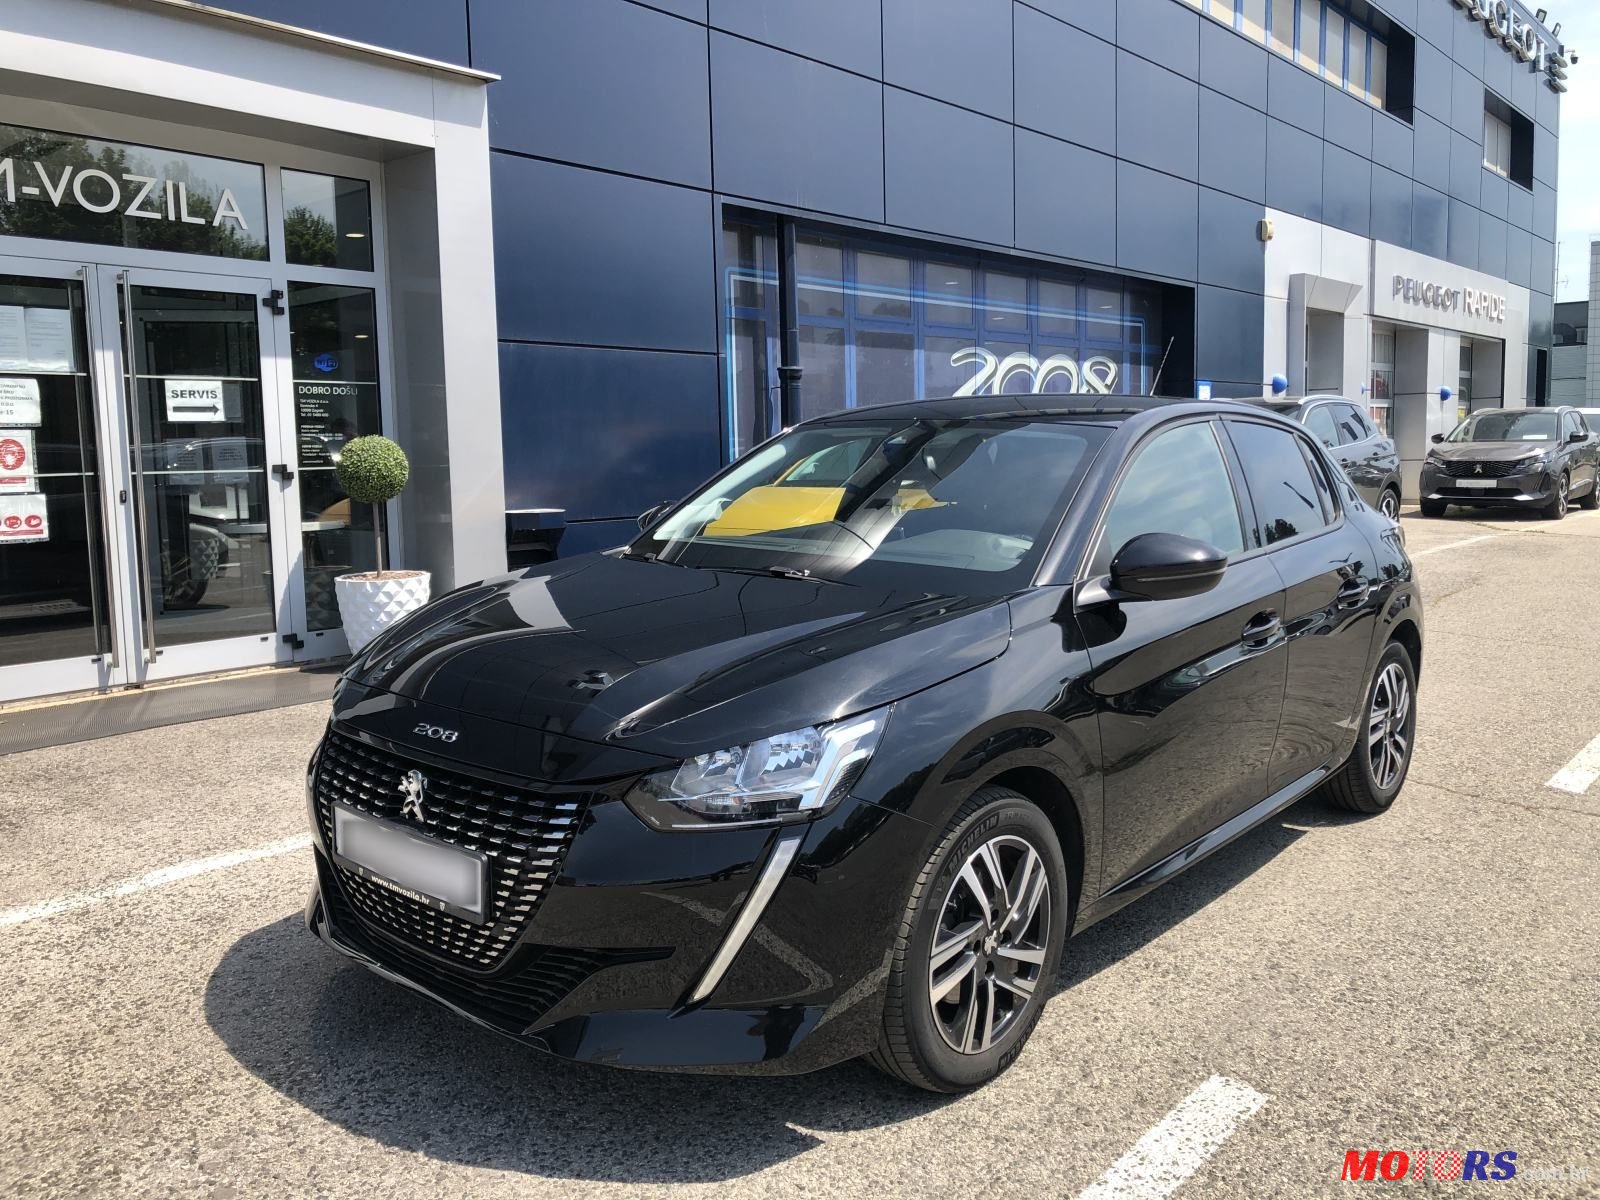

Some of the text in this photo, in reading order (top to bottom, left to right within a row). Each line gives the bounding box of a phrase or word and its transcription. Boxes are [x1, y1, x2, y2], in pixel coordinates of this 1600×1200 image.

[1454, 0, 1549, 72] UGEOT
[1393, 274, 1506, 321] PEUGEOT RAPIDE
[298, 385, 358, 396] DOBRO DOŠLI
[951, 346, 1119, 397] 2008
[171, 389, 218, 399] SERVIS
[412, 723, 459, 743] 208
[948, 814, 998, 873] MICHELIN
[371, 875, 430, 905] www.tmvozila.hr
